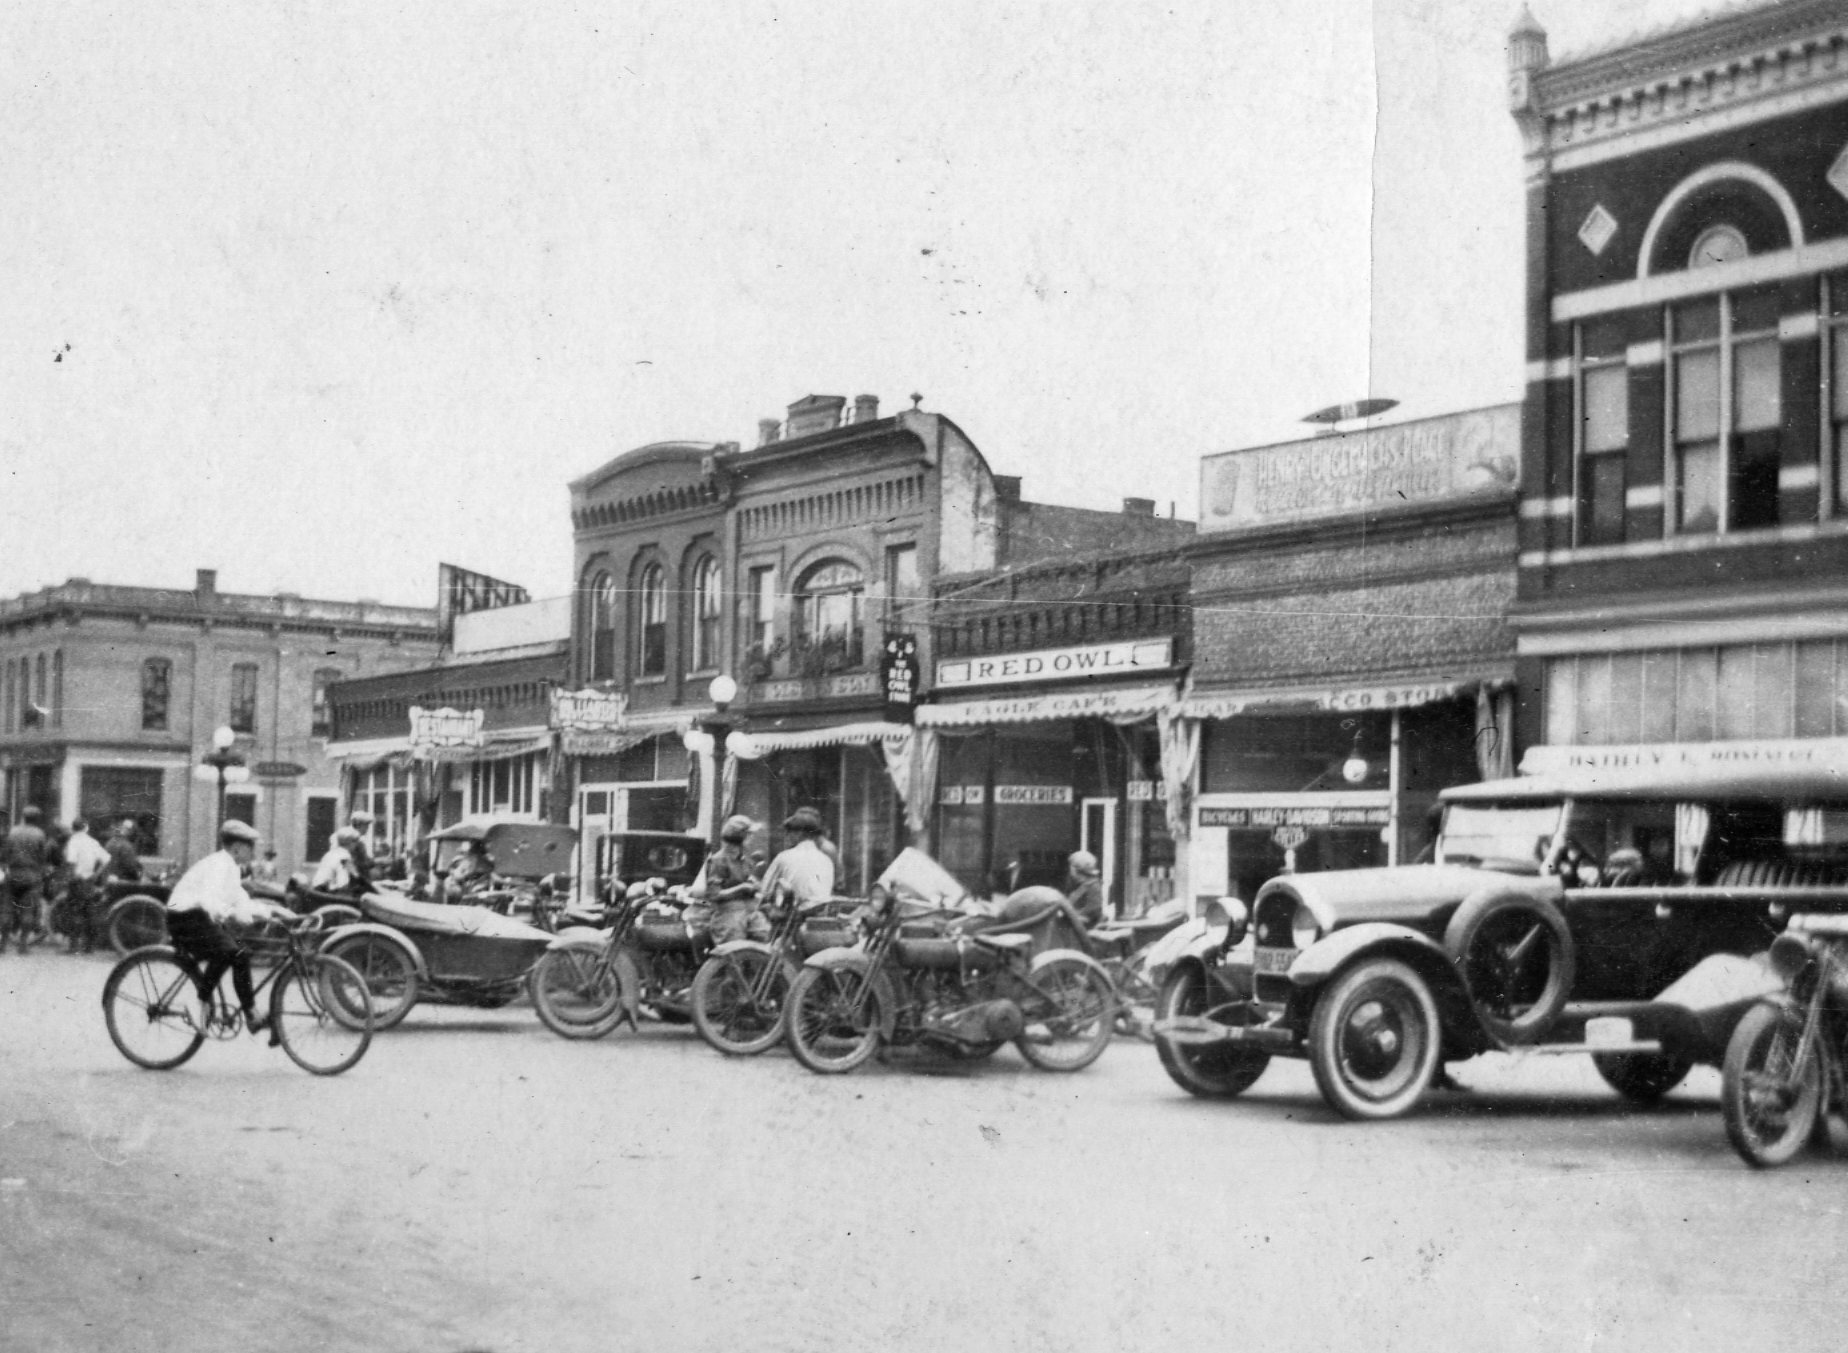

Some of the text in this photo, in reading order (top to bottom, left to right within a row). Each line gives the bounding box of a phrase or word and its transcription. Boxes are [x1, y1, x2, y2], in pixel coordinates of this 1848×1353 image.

[979, 650, 1124, 678] RED OWL
[1000, 787, 1066, 801] GROCERIES
[1202, 810, 1246, 824] BICYCLES
[1252, 808, 1330, 825] HARLEY-DAVIDSON
